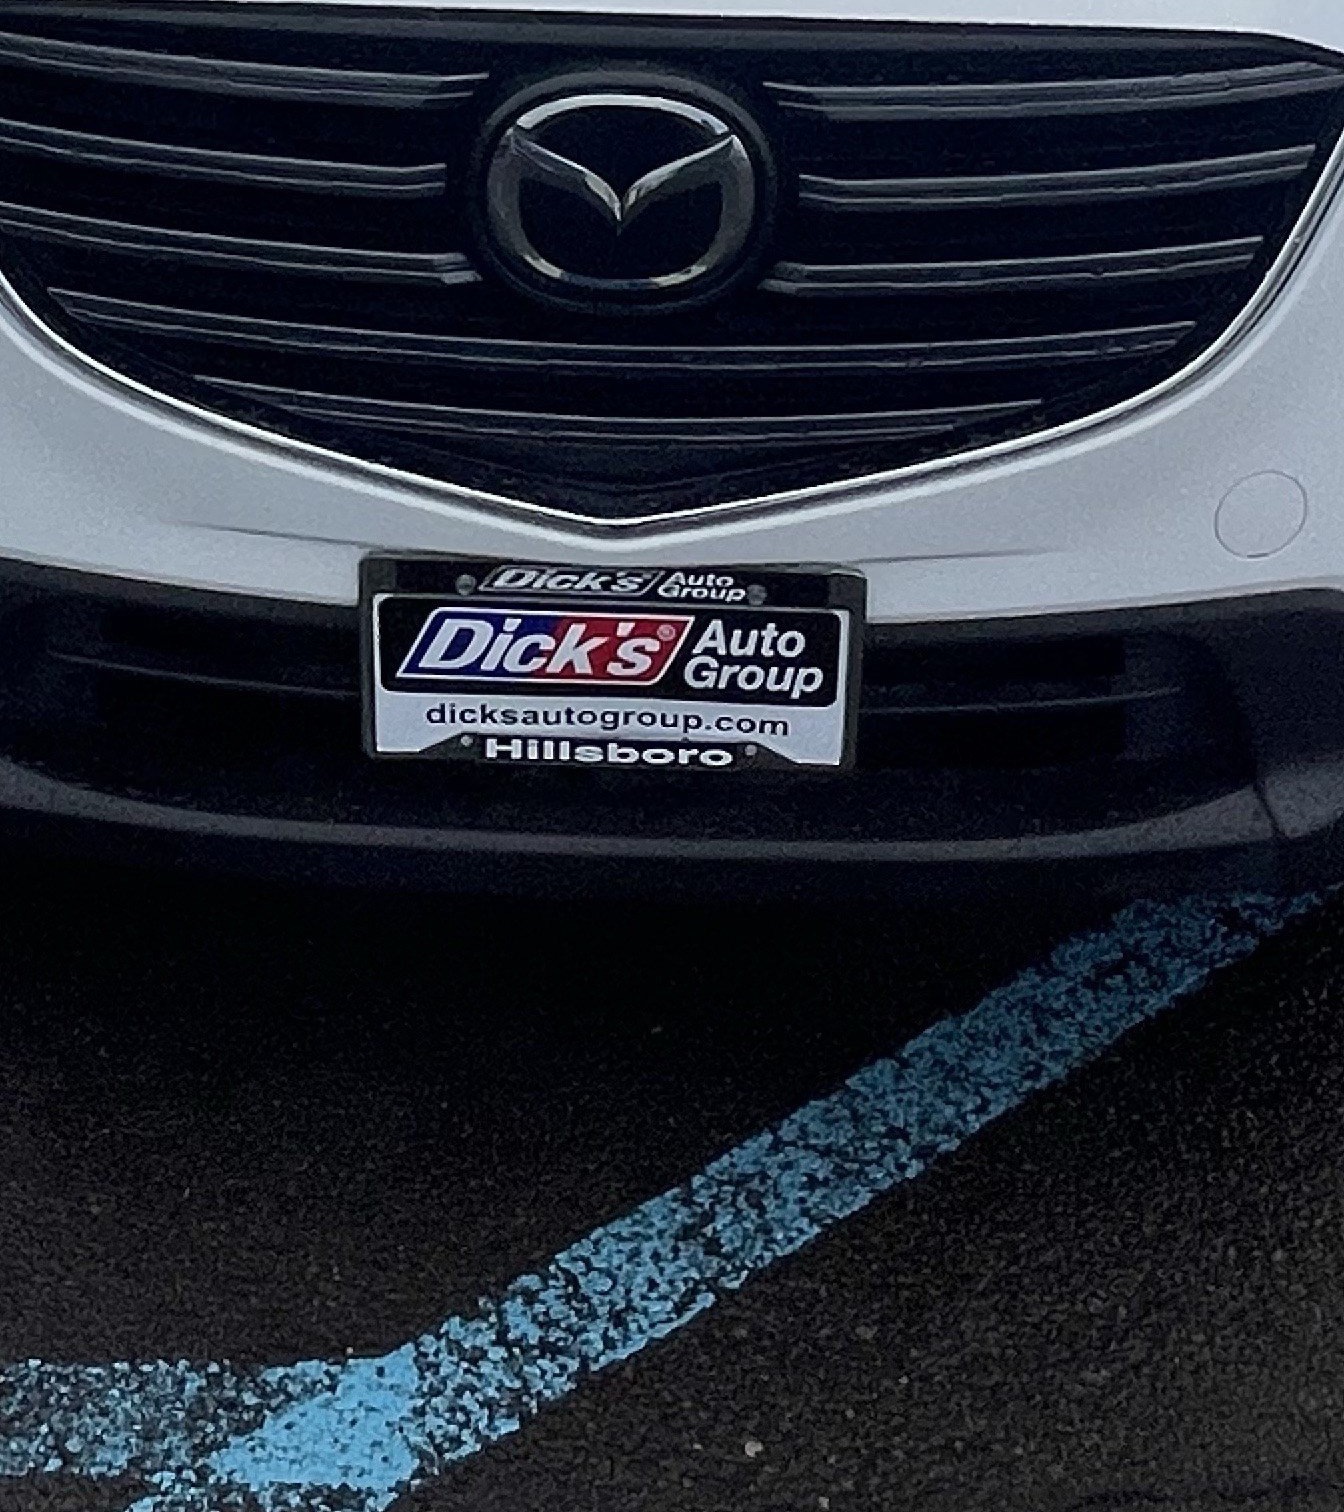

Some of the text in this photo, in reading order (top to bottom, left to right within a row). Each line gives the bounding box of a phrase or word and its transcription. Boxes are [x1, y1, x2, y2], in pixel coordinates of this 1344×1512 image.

[493, 568, 735, 593] Dick's Auto
[657, 583, 747, 603] Group
[418, 618, 807, 675] Dick's Auto
[683, 656, 824, 698] Group
[426, 702, 790, 736] dicksautogroup.com
[485, 739, 733, 766] Hillsboro
